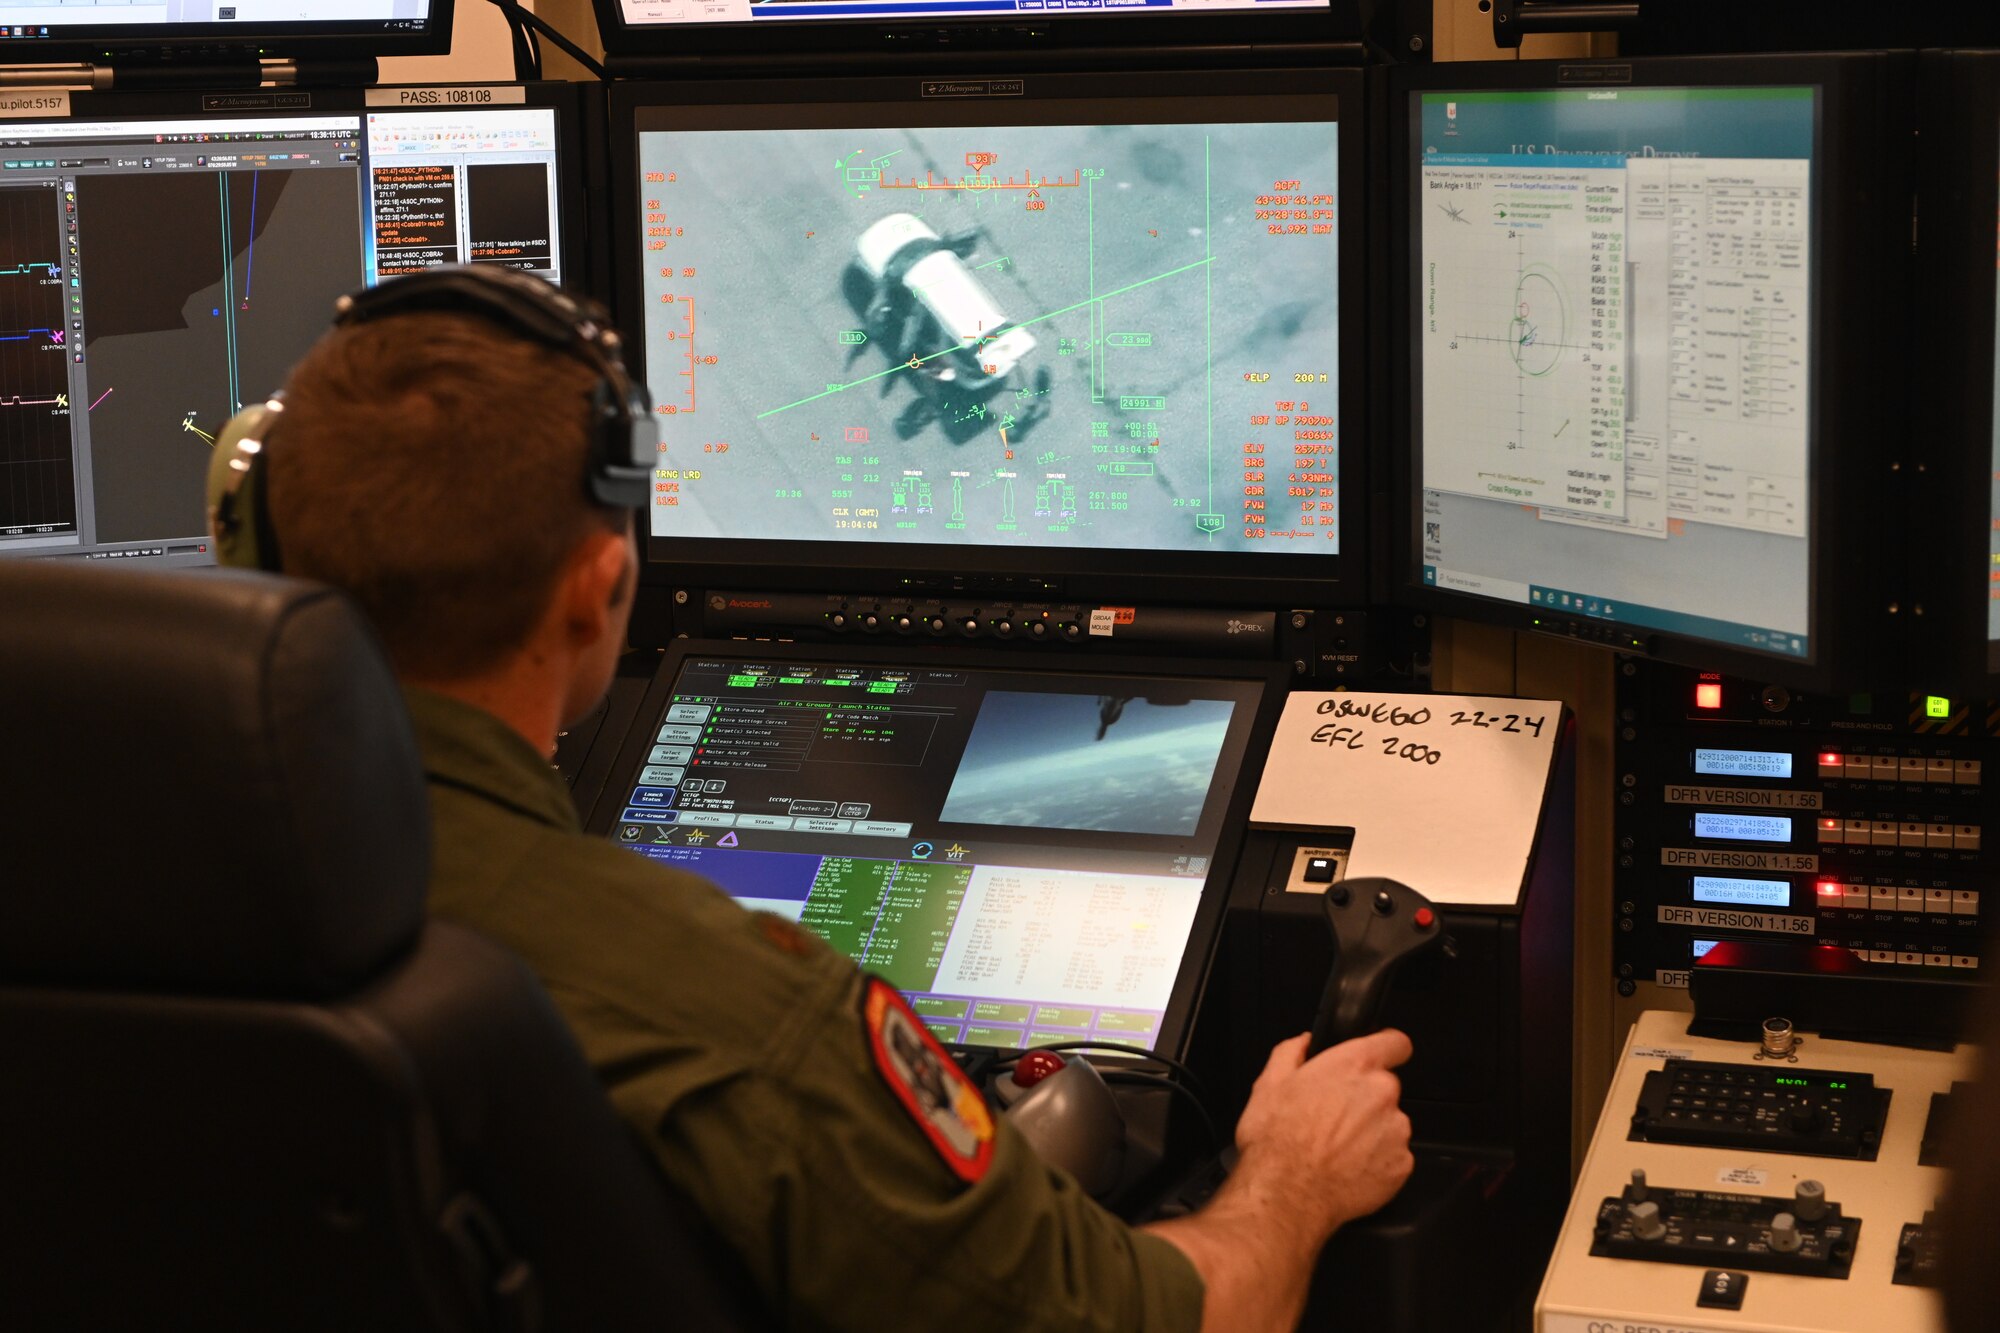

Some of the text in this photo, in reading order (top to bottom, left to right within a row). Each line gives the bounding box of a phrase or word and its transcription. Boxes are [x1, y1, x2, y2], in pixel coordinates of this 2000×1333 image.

[400, 90, 491, 104] PASS: 108108
[860, 171, 877, 179] 1.9
[1082, 168, 1105, 177] 20.3
[1274, 181, 1300, 191] ACFT
[1430, 181, 1442, 190] Bank
[1444, 181, 1459, 191] Angle
[1586, 186, 1604, 194] Current
[647, 200, 660, 210] 2X
[1026, 201, 1045, 211] 100
[1586, 205, 1598, 213] Time
[648, 214, 666, 223] DTV
[648, 226, 683, 237] RATE G
[1312, 224, 1333, 234] HAT
[647, 240, 666, 250] LAP
[683, 267, 696, 277] AV
[661, 294, 674, 303] 60
[844, 334, 862, 342] 110
[1294, 373, 1314, 382] 200
[1320, 373, 1328, 382] M
[1275, 402, 1308, 411] TGT A
[1091, 422, 1158, 430] TOF +00:51
[1130, 430, 1159, 438] 00:00
[704, 444, 729, 453] A 77
[1091, 445, 1159, 454] TOI 19:04:55
[836, 457, 879, 465] TAS 166
[1244, 458, 1315, 468] BRG 197
[1114, 464, 1126, 472] 48
[656, 470, 702, 480] TRNG LRD
[656, 483, 679, 492] SAFE
[1244, 486, 1316, 497] GDR 5017
[1088, 492, 1128, 500] 267.800
[656, 496, 678, 506] 1121
[1172, 498, 1201, 507] 29.92
[1244, 500, 1316, 511] FVW 17
[1088, 502, 1128, 510] 121.500
[832, 508, 880, 518] CLK (GMT)
[836, 520, 878, 528] 19:04:04
[1202, 518, 1220, 526] 108
[1244, 514, 1314, 526] FVH 11
[1244, 528, 1265, 538] C/S
[1238, 622, 1262, 632] CYBEX
[1338, 654, 1358, 662] RESET
[1700, 672, 1721, 680] MODE
[1316, 699, 1545, 738] OSWEGO 22-24
[1758, 718, 1786, 726] STATION
[1872, 722, 1893, 730] HOLD
[1382, 736, 1441, 765] 2000
[1671, 789, 1817, 807] DFR VERSION 1.1.56
[1668, 850, 1814, 870] DFR VERSION 1.1.56
[1664, 908, 1810, 932] DFR VERSION 1.1.56
